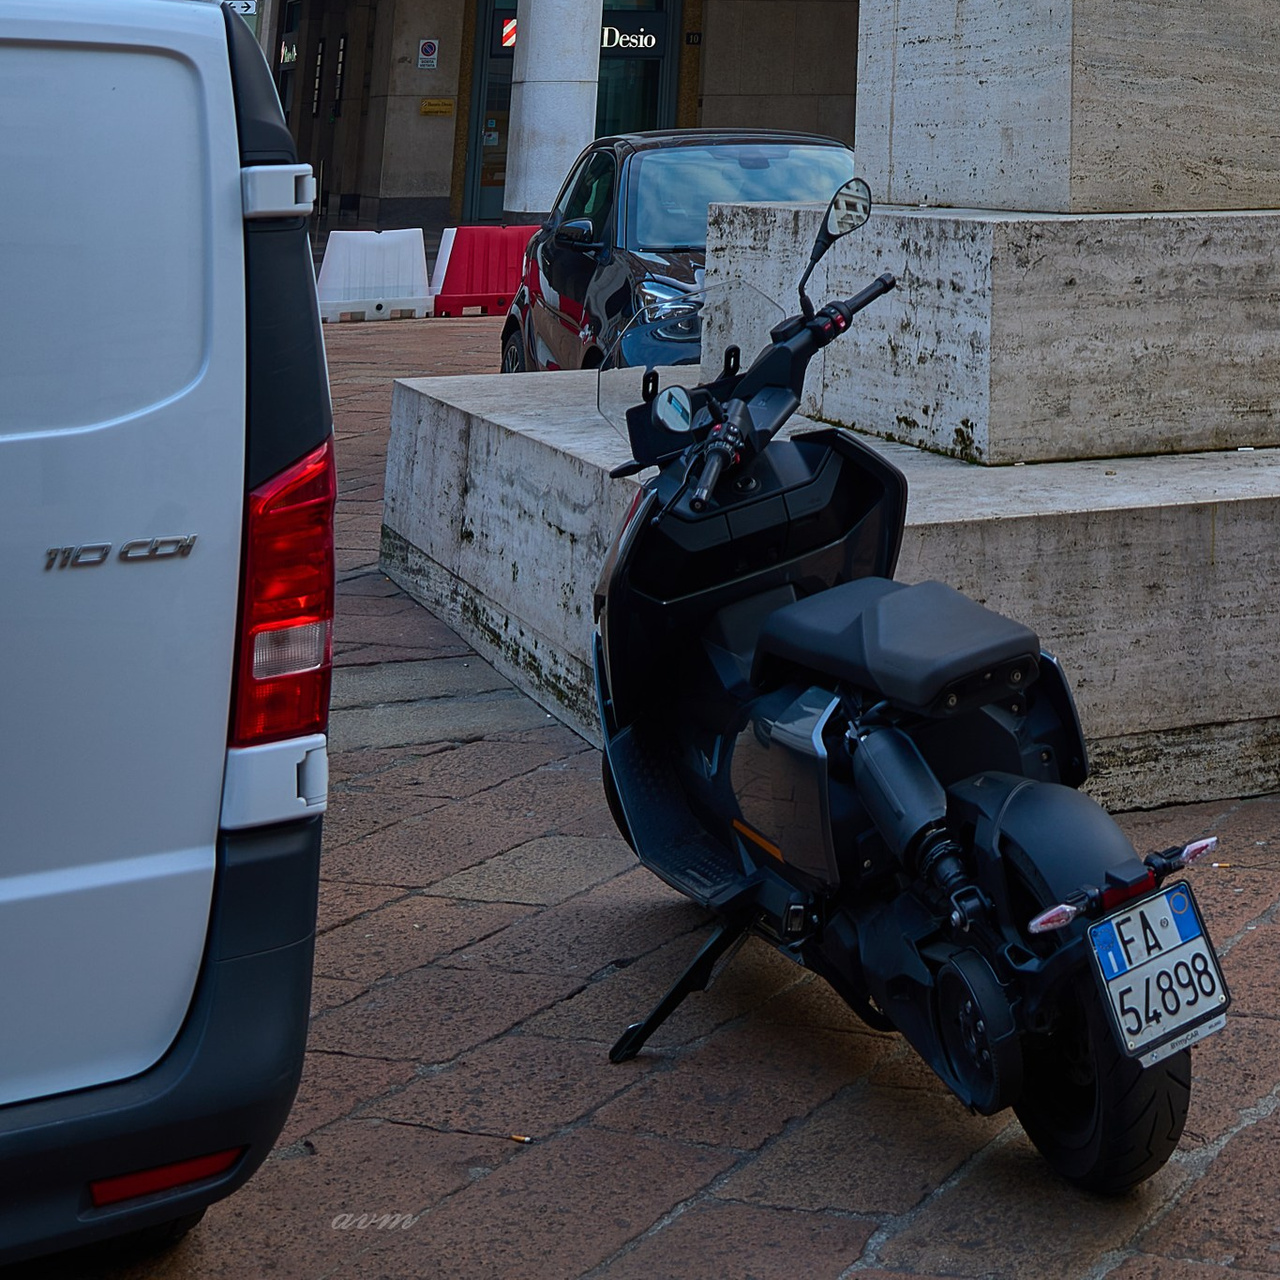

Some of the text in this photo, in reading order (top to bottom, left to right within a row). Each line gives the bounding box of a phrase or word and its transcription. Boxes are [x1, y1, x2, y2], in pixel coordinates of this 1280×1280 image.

[601, 26, 656, 48] Desio
[44, 533, 199, 571] 110 CDI
[1114, 909, 1163, 966] FA
[1118, 951, 1217, 1036] 54898
